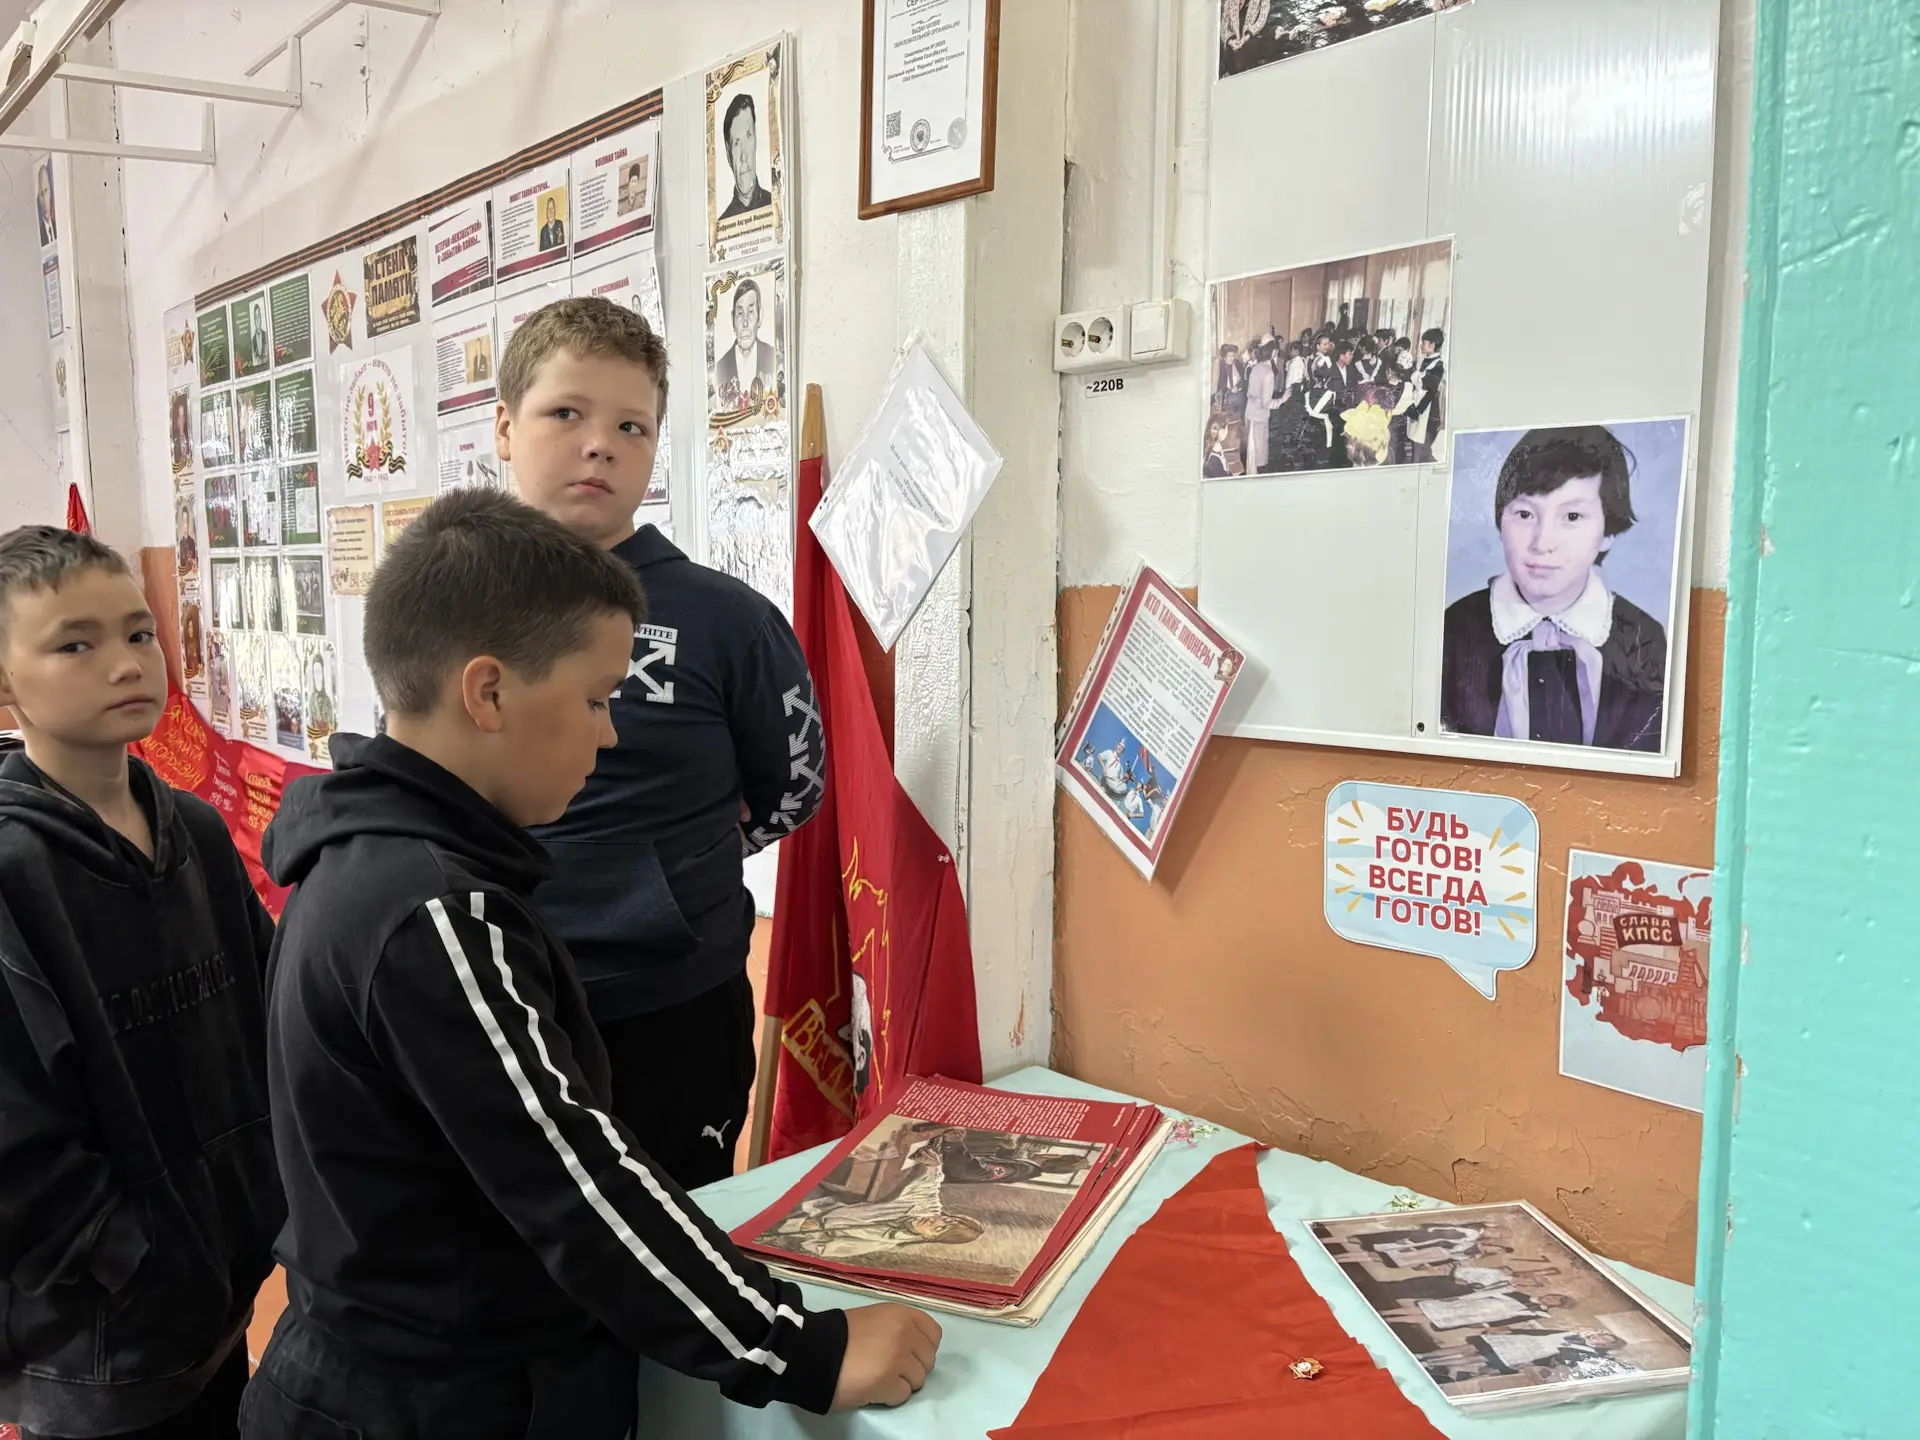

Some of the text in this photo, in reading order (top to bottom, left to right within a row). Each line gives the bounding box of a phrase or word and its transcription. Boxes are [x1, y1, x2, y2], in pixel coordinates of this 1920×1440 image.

[373, 247, 407, 281] СТЕНА
[371, 272, 412, 307] ПАМЯТИ
[368, 392, 374, 417] 9
[1143, 591, 1216, 669] КТО ТАКИЕ ПИОНЕРЫ
[140, 735, 206, 791] ИГОРЬЕВИЧ
[1387, 806, 1469, 842] БУДЬ
[1375, 835, 1482, 874] ГОТОВ!
[1368, 863, 1488, 907] ВСЕГДА
[1375, 895, 1482, 937] ГОТОВ!
[1619, 916, 1671, 929] СЛАВА
[1621, 926, 1673, 943] КПСС
